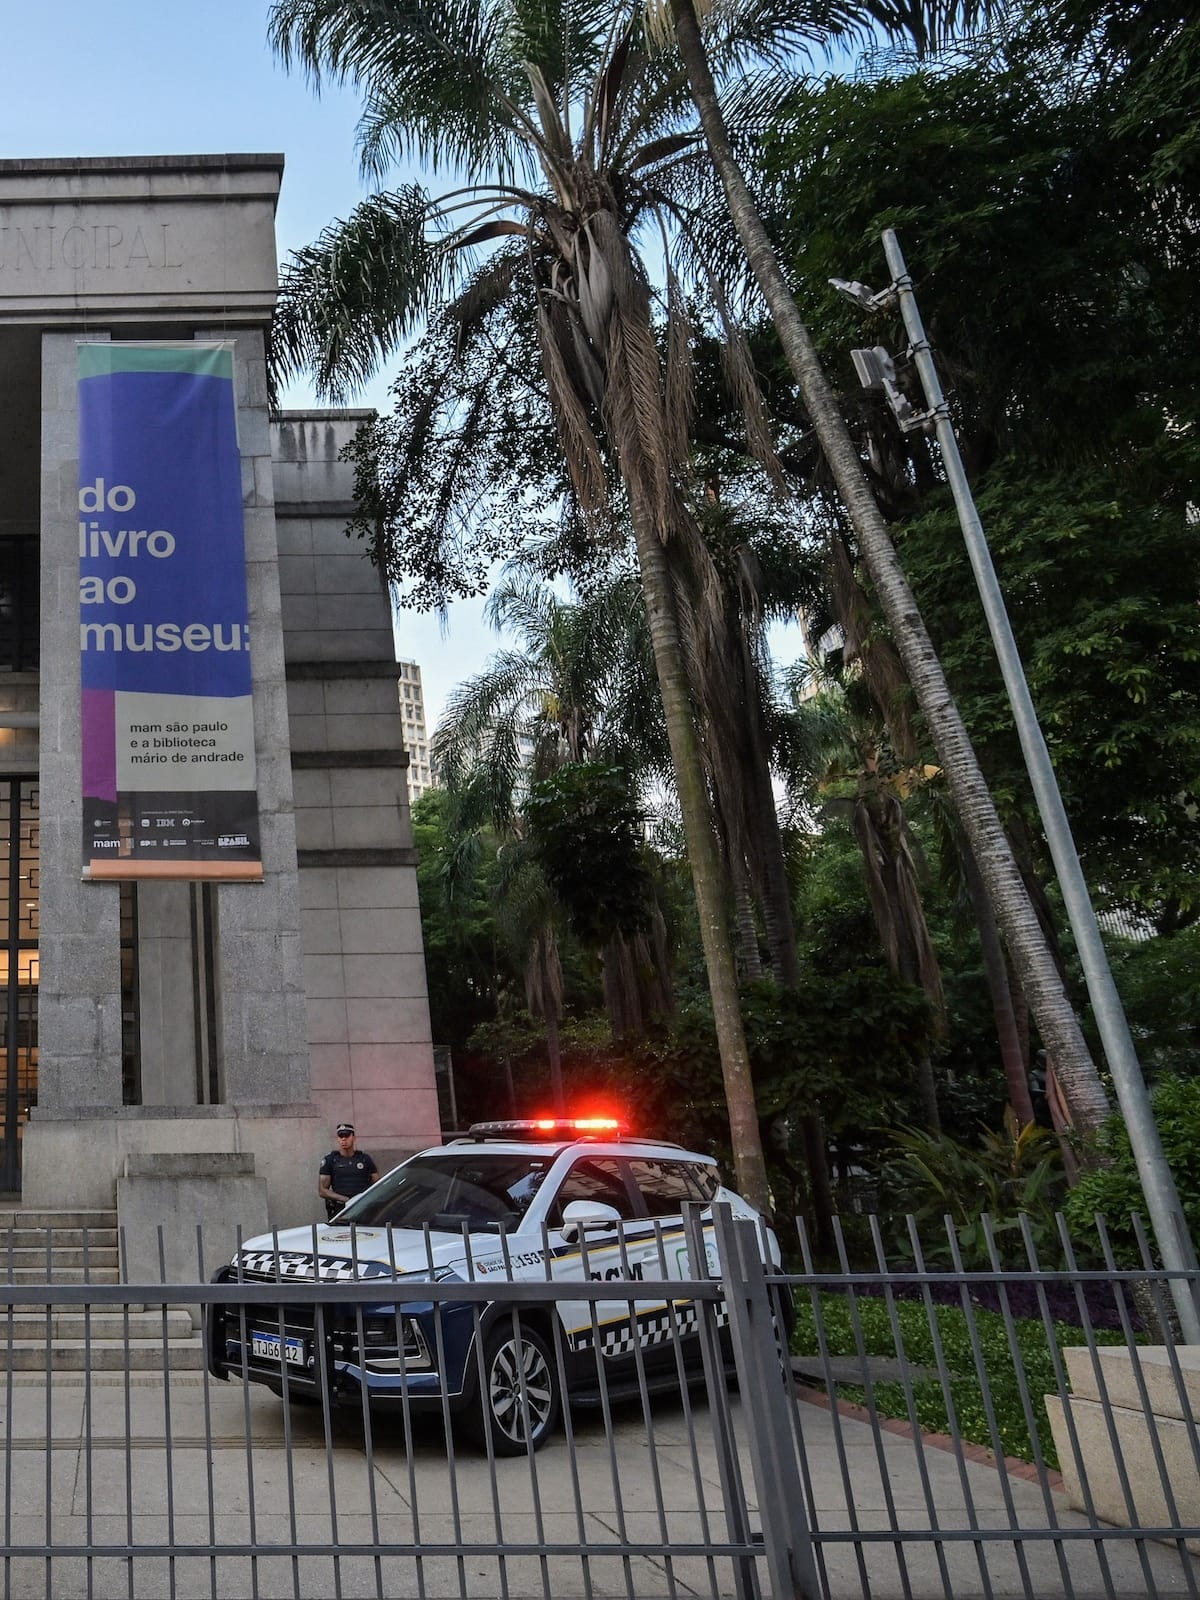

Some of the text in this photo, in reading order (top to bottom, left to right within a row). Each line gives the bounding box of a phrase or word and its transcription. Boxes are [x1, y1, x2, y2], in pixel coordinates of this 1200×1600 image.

[78, 477, 136, 514] do
[79, 522, 176, 559] livro
[79, 575, 137, 605] ao
[130, 721, 228, 734] mam são paulo
[130, 737, 216, 748] e a biblioteca
[131, 751, 244, 764] mário de andrade
[156, 818, 175, 827] IBM
[93, 840, 121, 848] mam
[256, 1340, 298, 1361] TJG612
